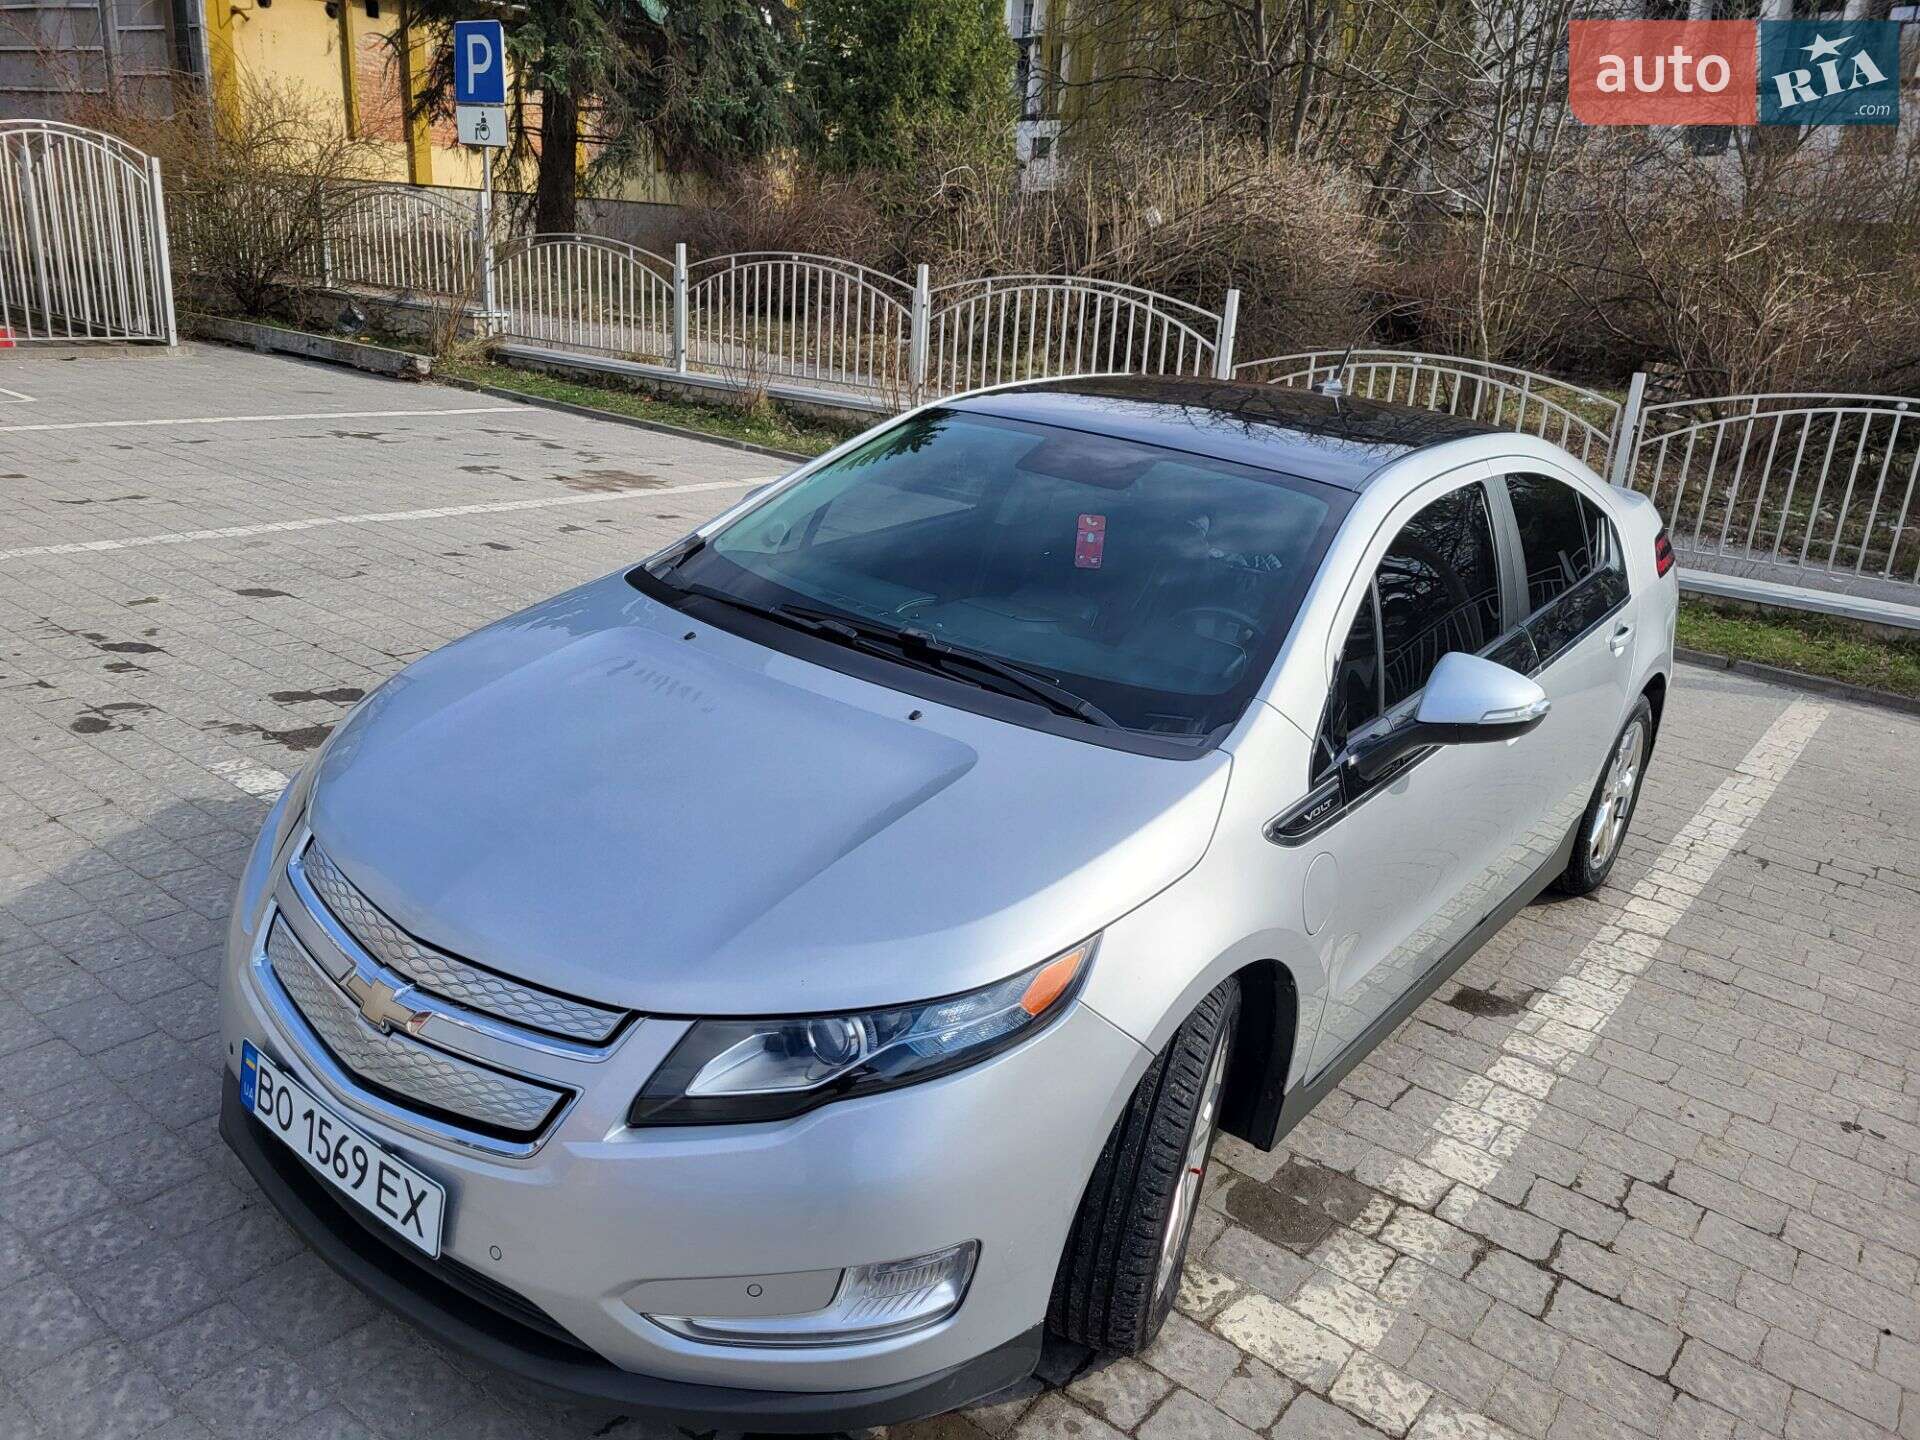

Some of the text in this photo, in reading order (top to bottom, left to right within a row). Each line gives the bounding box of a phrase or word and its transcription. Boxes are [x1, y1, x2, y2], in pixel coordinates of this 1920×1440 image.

[467, 34, 492, 94] P
[1304, 799, 1332, 820] VOLT
[257, 1066, 428, 1238] BO 1569 EX
